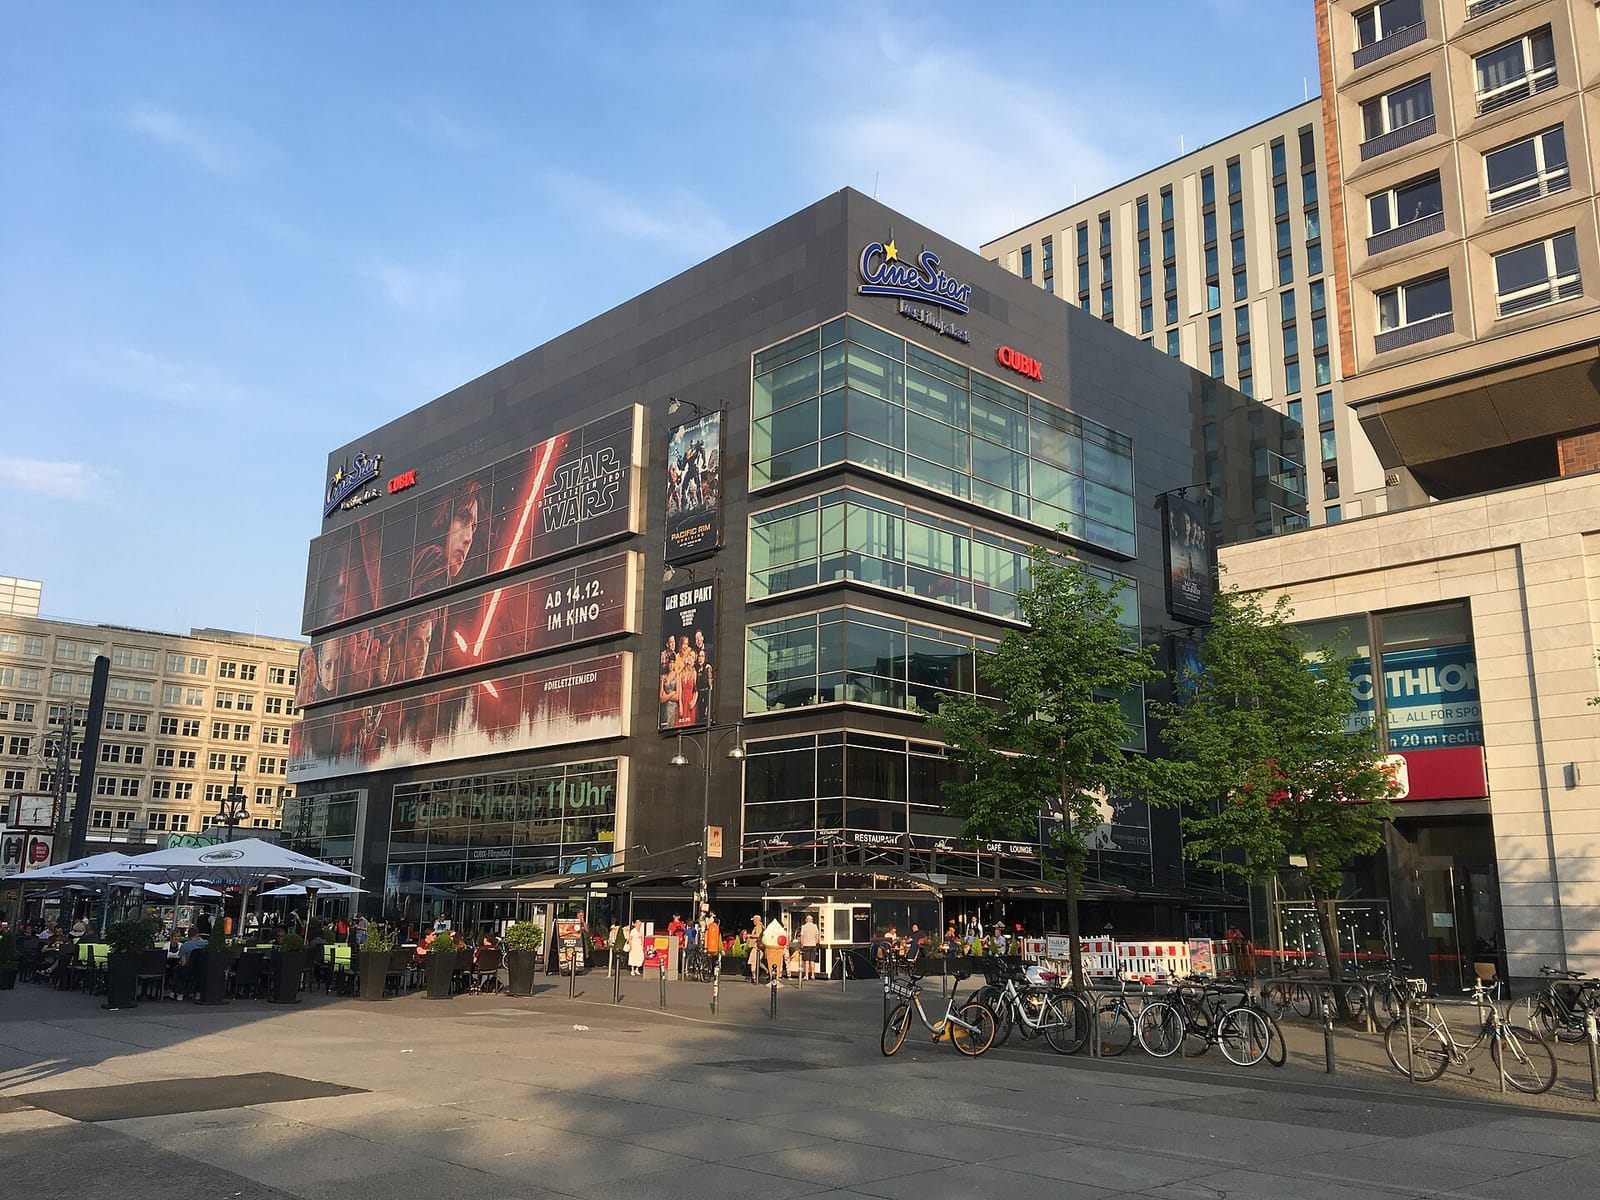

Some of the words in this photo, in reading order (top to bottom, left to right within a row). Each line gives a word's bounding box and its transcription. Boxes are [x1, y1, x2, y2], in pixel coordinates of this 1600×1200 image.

[860, 240, 971, 303] CineStar
[997, 345, 1042, 381] CUBIX
[387, 468, 417, 494] CUBIX
[544, 447, 620, 498] STAR
[543, 482, 619, 533] WARS
[671, 527, 697, 541] PACIFIC
[698, 523, 711, 533] RIM
[545, 590, 562, 610] AB
[566, 579, 604, 604] 14.12.
[665, 594, 679, 611] DER
[679, 590, 693, 607] SEX
[693, 585, 713, 604] PAKT
[547, 611, 562, 631] IM
[566, 603, 600, 626] KINO
[543, 672, 598, 692] #DIELETZTENJEDI
[1406, 712, 1427, 722] ALL
[1431, 709, 1453, 720] FOR
[1456, 706, 1480, 718] SPO
[1401, 734, 1420, 747] 20
[1424, 734, 1438, 744] m
[1442, 728, 1481, 744] recht
[399, 795, 463, 827] Täglich
[473, 793, 515, 817] Kino
[521, 794, 542, 812] ab
[547, 781, 564, 810] 11
[569, 781, 612, 809] Uhr
[986, 842, 1002, 852] CAFÉ
[1010, 845, 1033, 854] LOUNGE
